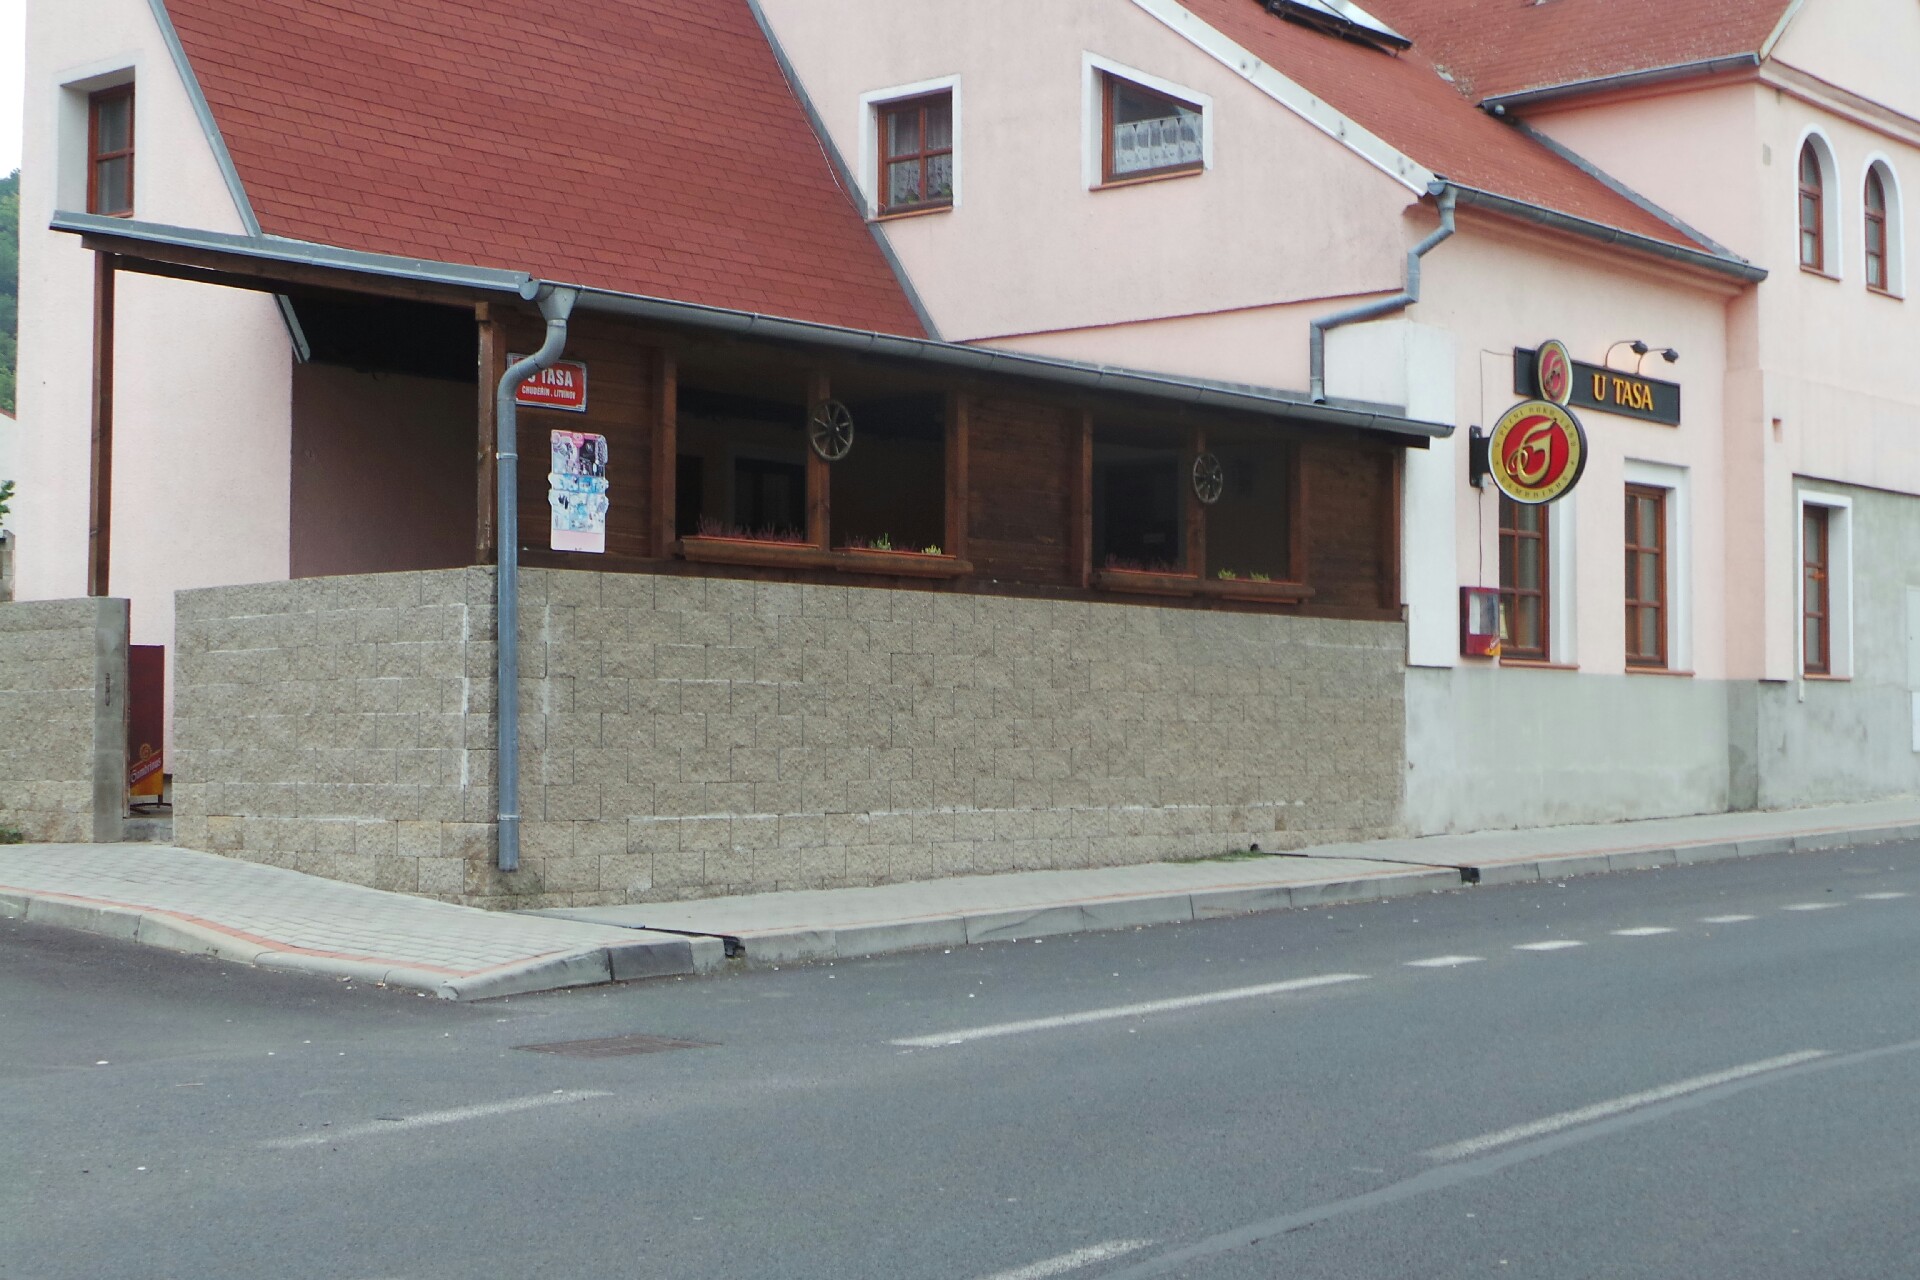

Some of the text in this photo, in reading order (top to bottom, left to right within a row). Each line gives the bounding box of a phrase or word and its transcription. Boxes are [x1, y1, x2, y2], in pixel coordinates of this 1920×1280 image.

[541, 367, 573, 387] TASA
[1593, 374, 1654, 411] U TASA
